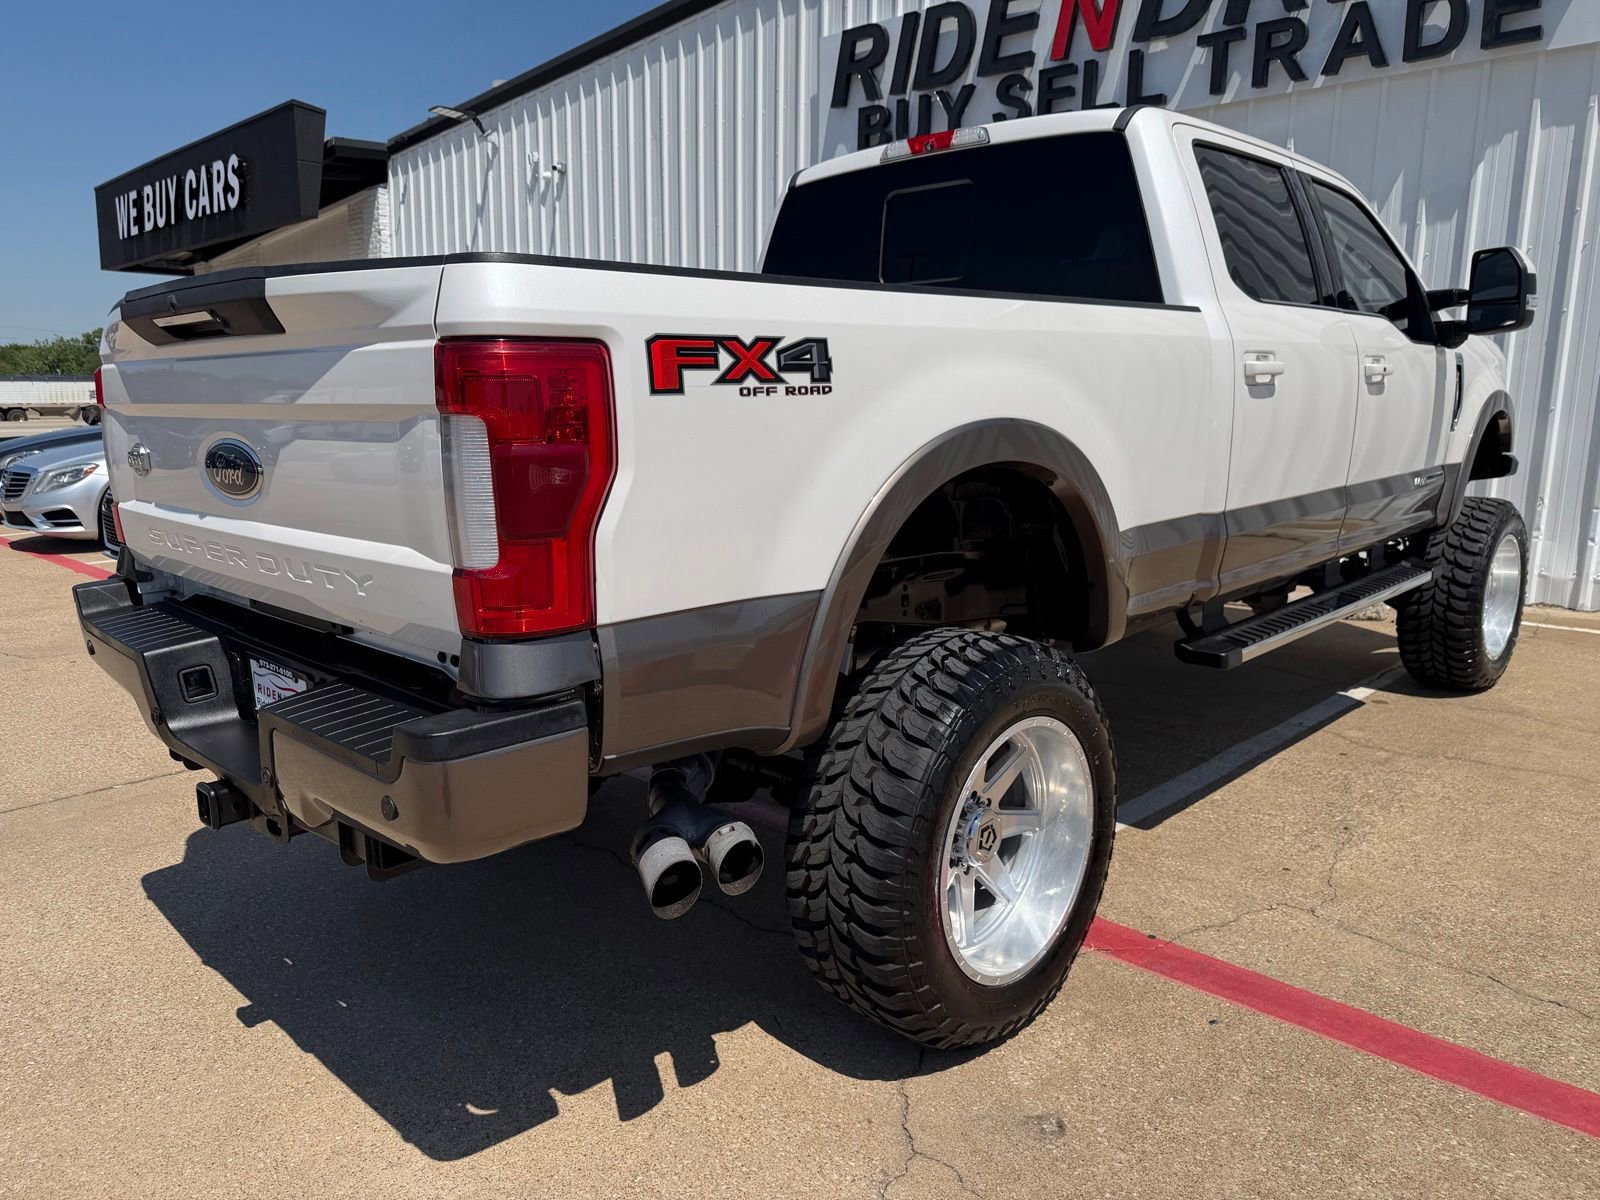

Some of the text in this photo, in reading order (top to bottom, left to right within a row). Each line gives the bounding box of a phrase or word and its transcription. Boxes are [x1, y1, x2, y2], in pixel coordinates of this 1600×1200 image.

[857, 0, 1544, 151] BUY SELL TRADE
[115, 153, 241, 240] WE BUY CARS
[645, 332, 833, 396] FX4
[739, 385, 832, 397] OFF ROAD
[213, 451, 245, 486] Ford
[149, 527, 374, 597] SUPER DUTY
